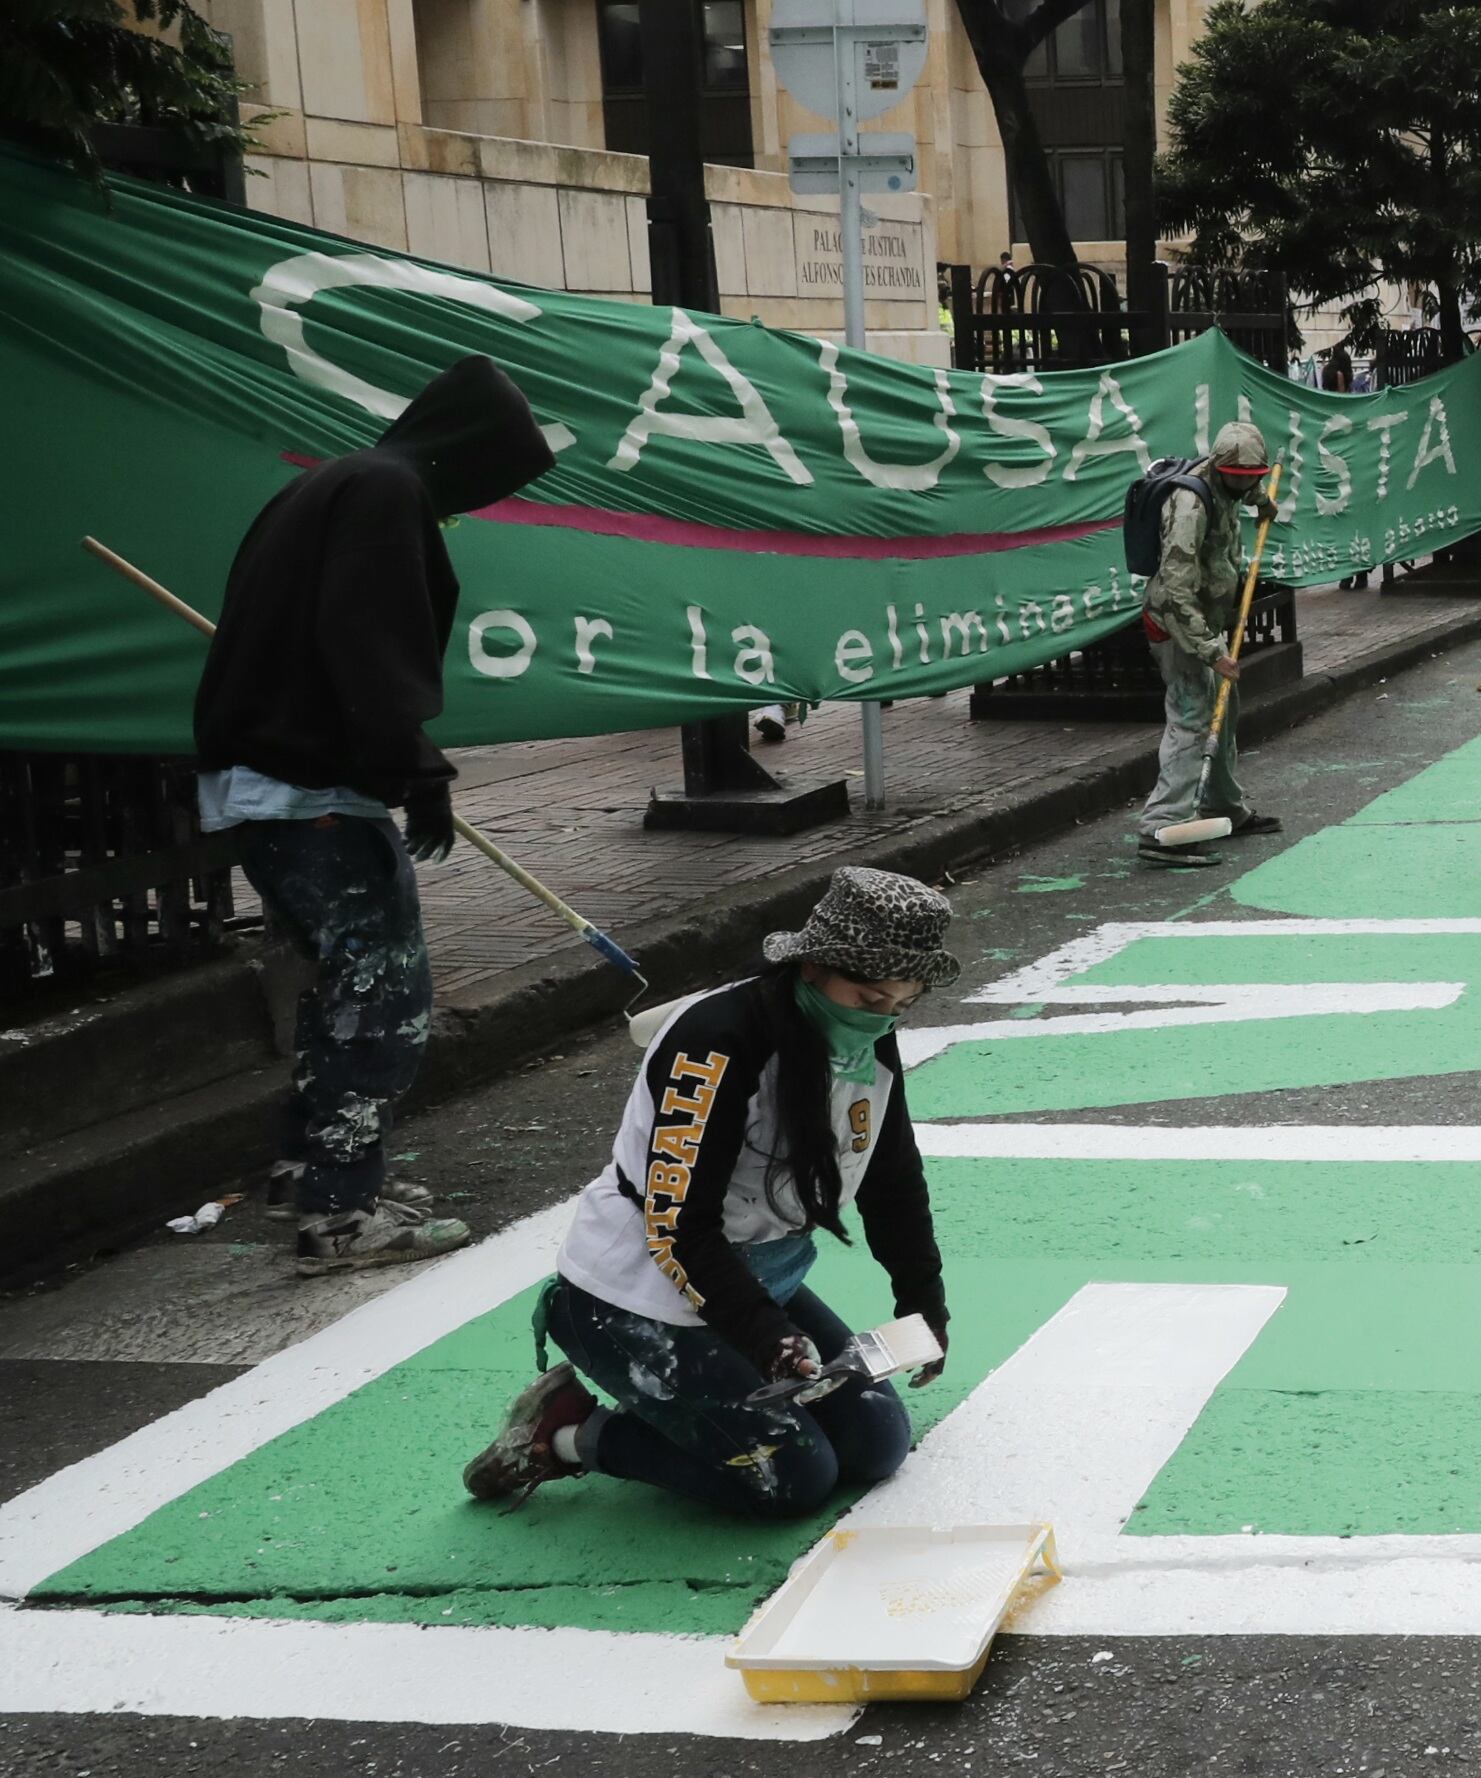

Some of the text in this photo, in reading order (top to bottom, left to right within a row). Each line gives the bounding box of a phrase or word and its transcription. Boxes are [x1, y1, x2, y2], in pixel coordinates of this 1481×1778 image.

[868, 235, 906, 258] JUSTICIA
[250, 251, 1152, 499] CAUSA
[468, 609, 613, 678] or
[686, 605, 778, 686] la
[848, 1098, 871, 1154] 9
